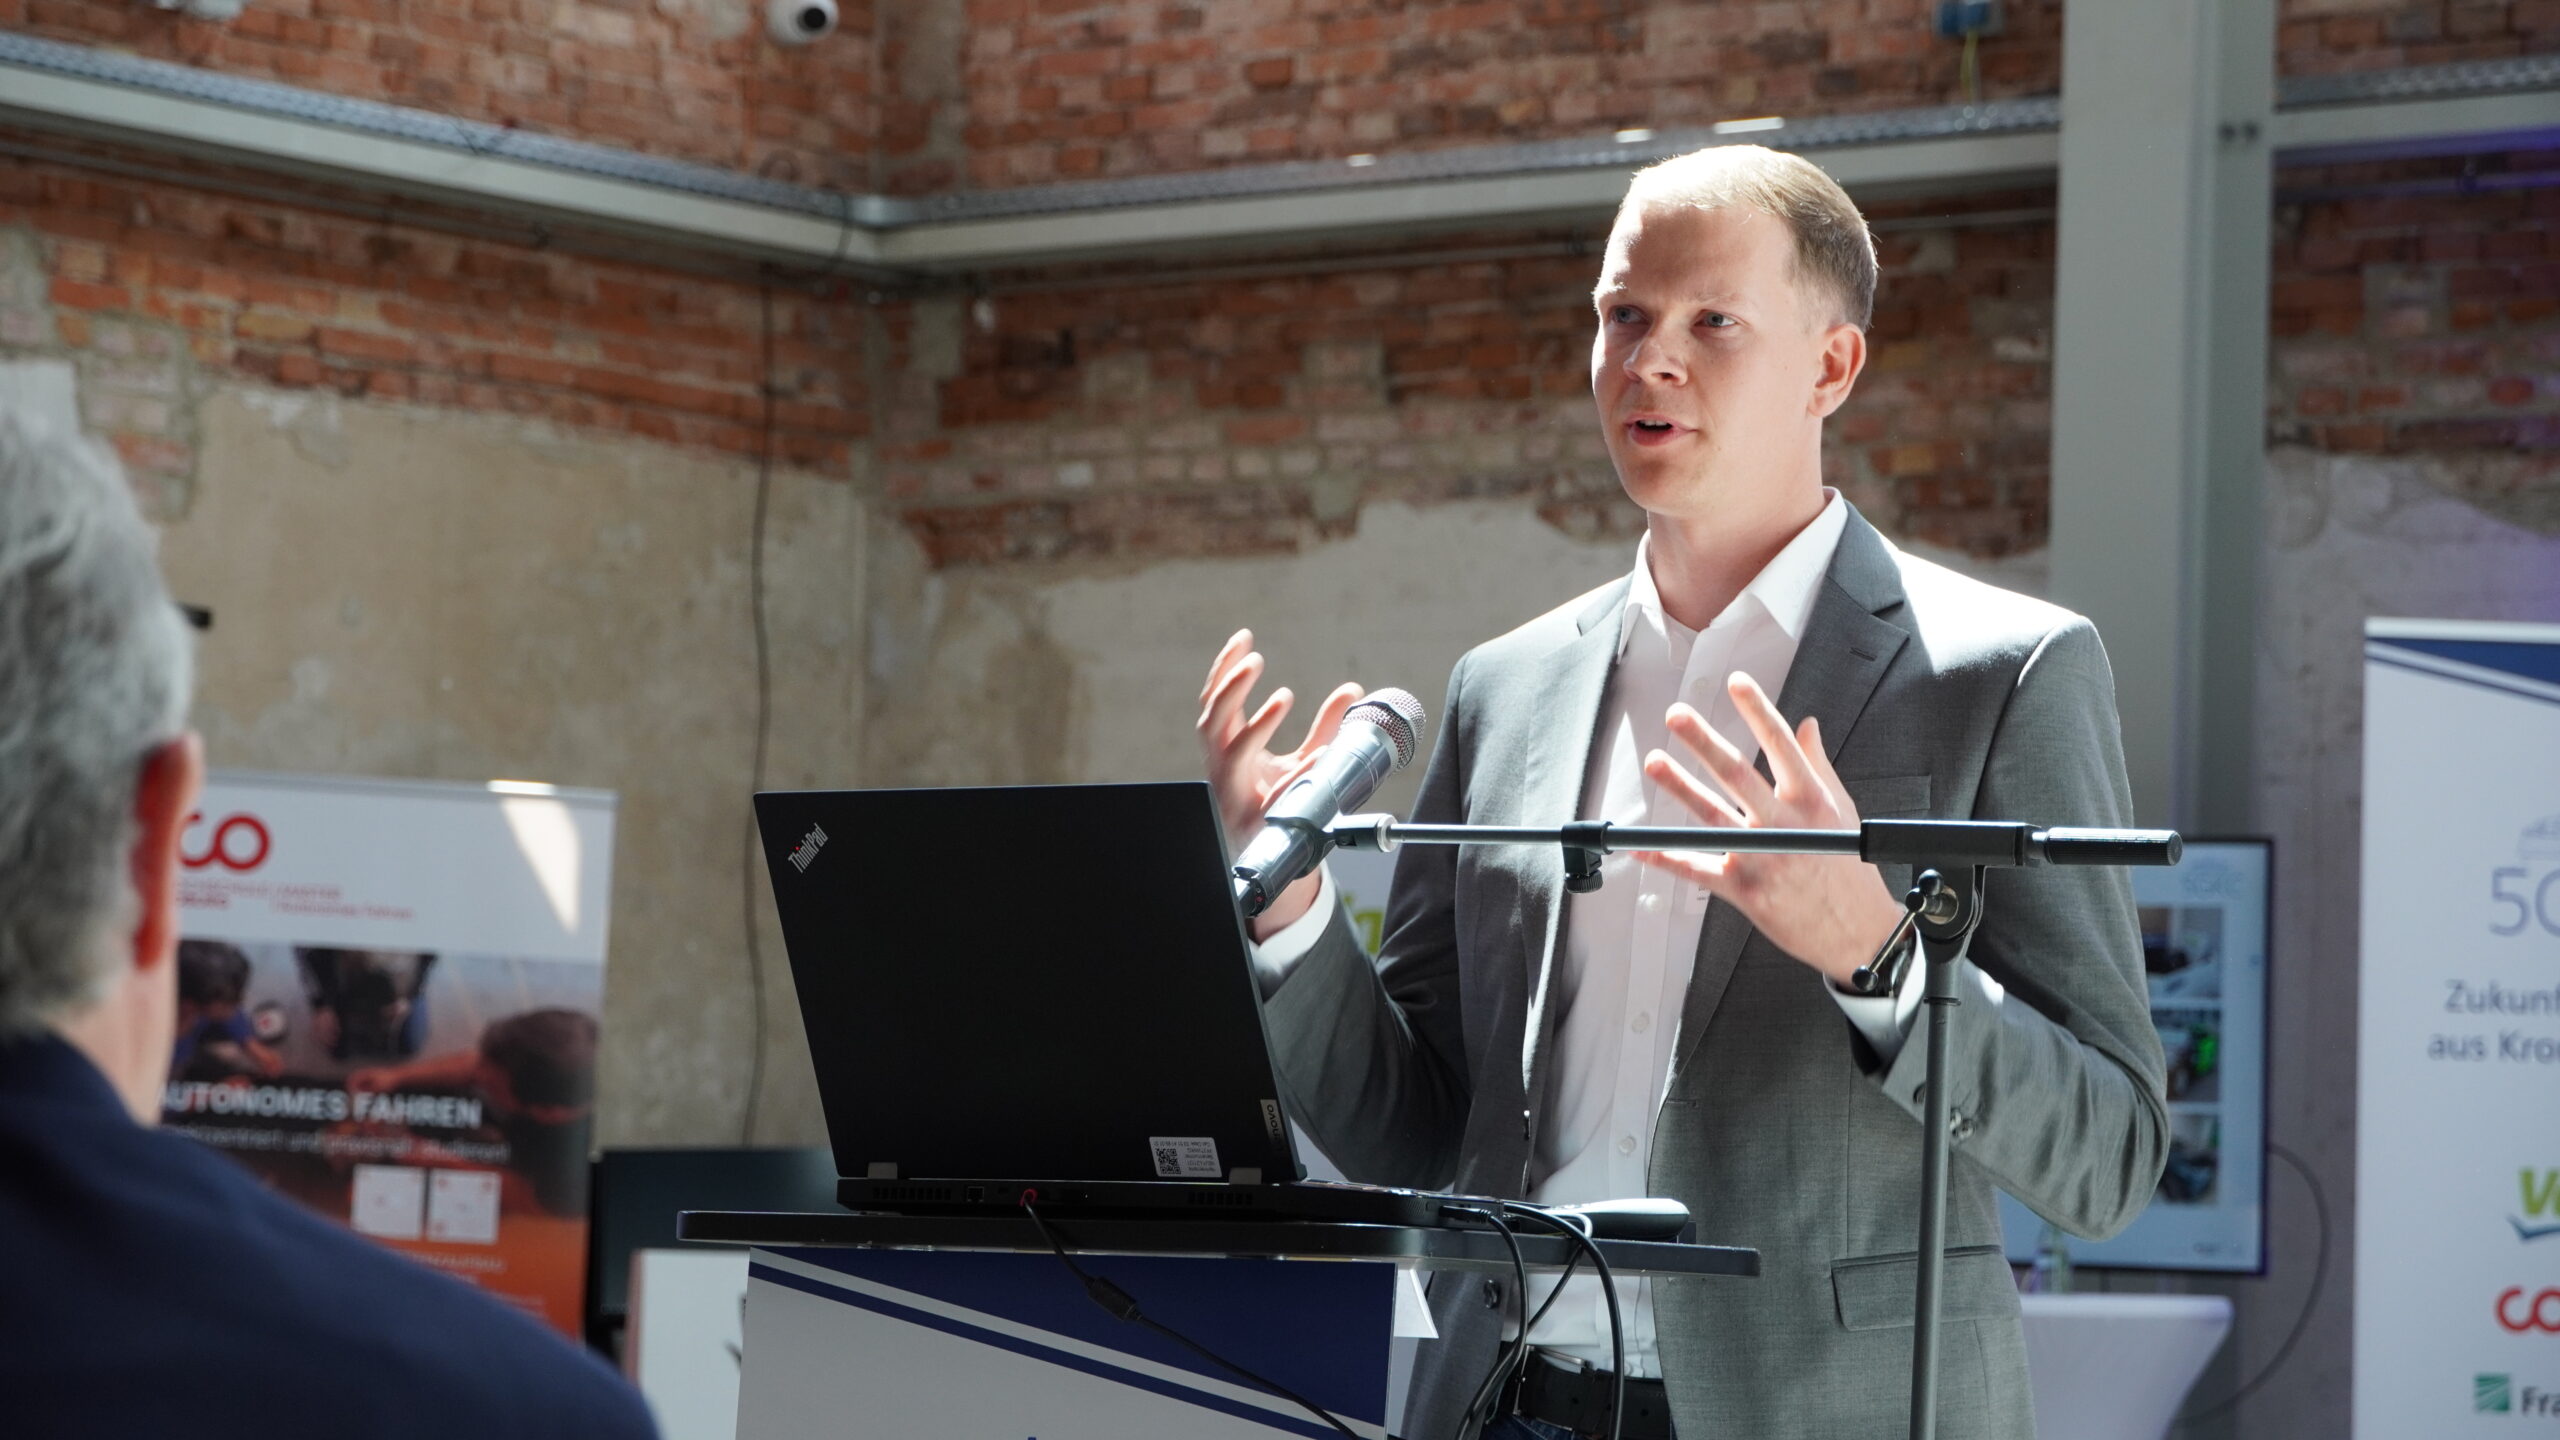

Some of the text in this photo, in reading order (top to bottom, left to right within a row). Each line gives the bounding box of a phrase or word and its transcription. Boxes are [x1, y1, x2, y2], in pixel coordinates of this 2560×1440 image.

[788, 822, 828, 873] ThinkPad
[2427, 1029, 2560, 1064] aus Kro
[352, 1092, 483, 1128] FAHREN
